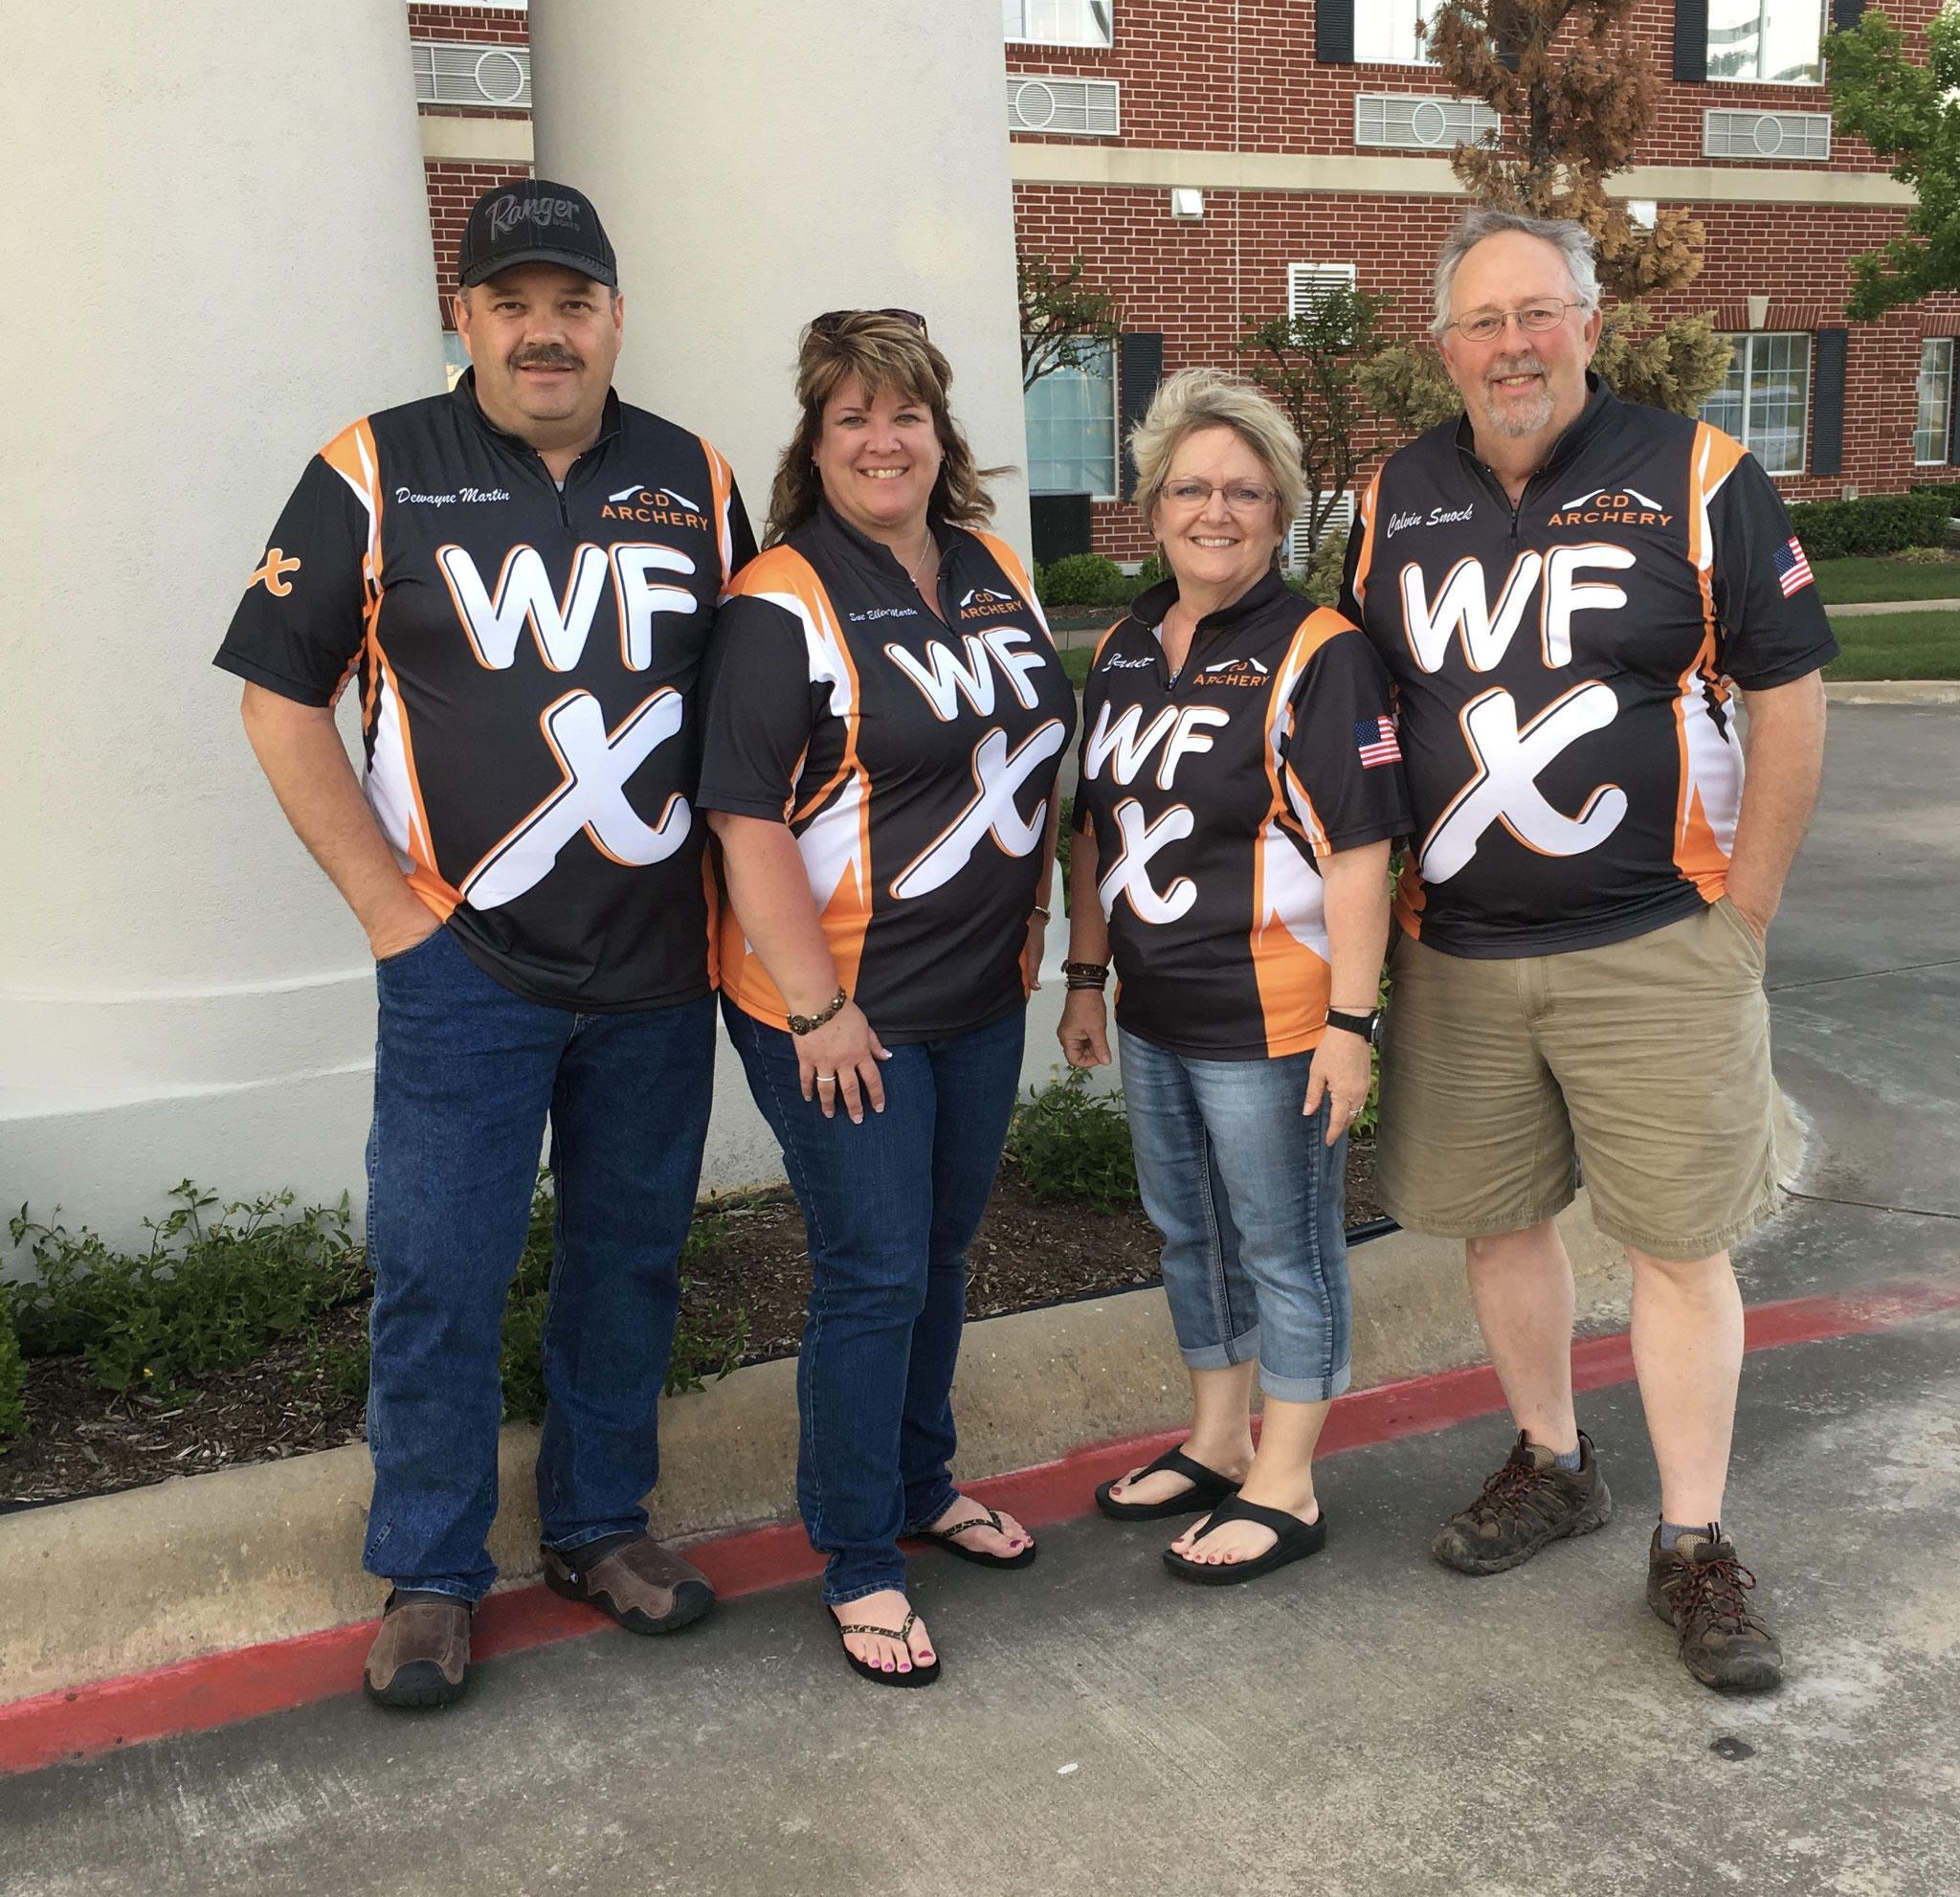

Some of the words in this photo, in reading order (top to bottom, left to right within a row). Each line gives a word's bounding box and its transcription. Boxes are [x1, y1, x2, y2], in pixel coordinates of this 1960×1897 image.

[485, 193, 580, 244] Ranger
[395, 486, 457, 508] Dewayne
[459, 487, 511, 503] Martin
[638, 491, 670, 507] CD
[1594, 494, 1630, 509] CD
[601, 504, 709, 532] ARCHERY
[1388, 512, 1423, 539] Calvin
[1425, 503, 1475, 527] Smock
[1547, 510, 1674, 527] ARCHERY
[974, 592, 994, 604] CD
[889, 607, 919, 618] Martin
[960, 600, 1024, 620] ARCHERY
[1192, 673, 1271, 687] ARCHERY
